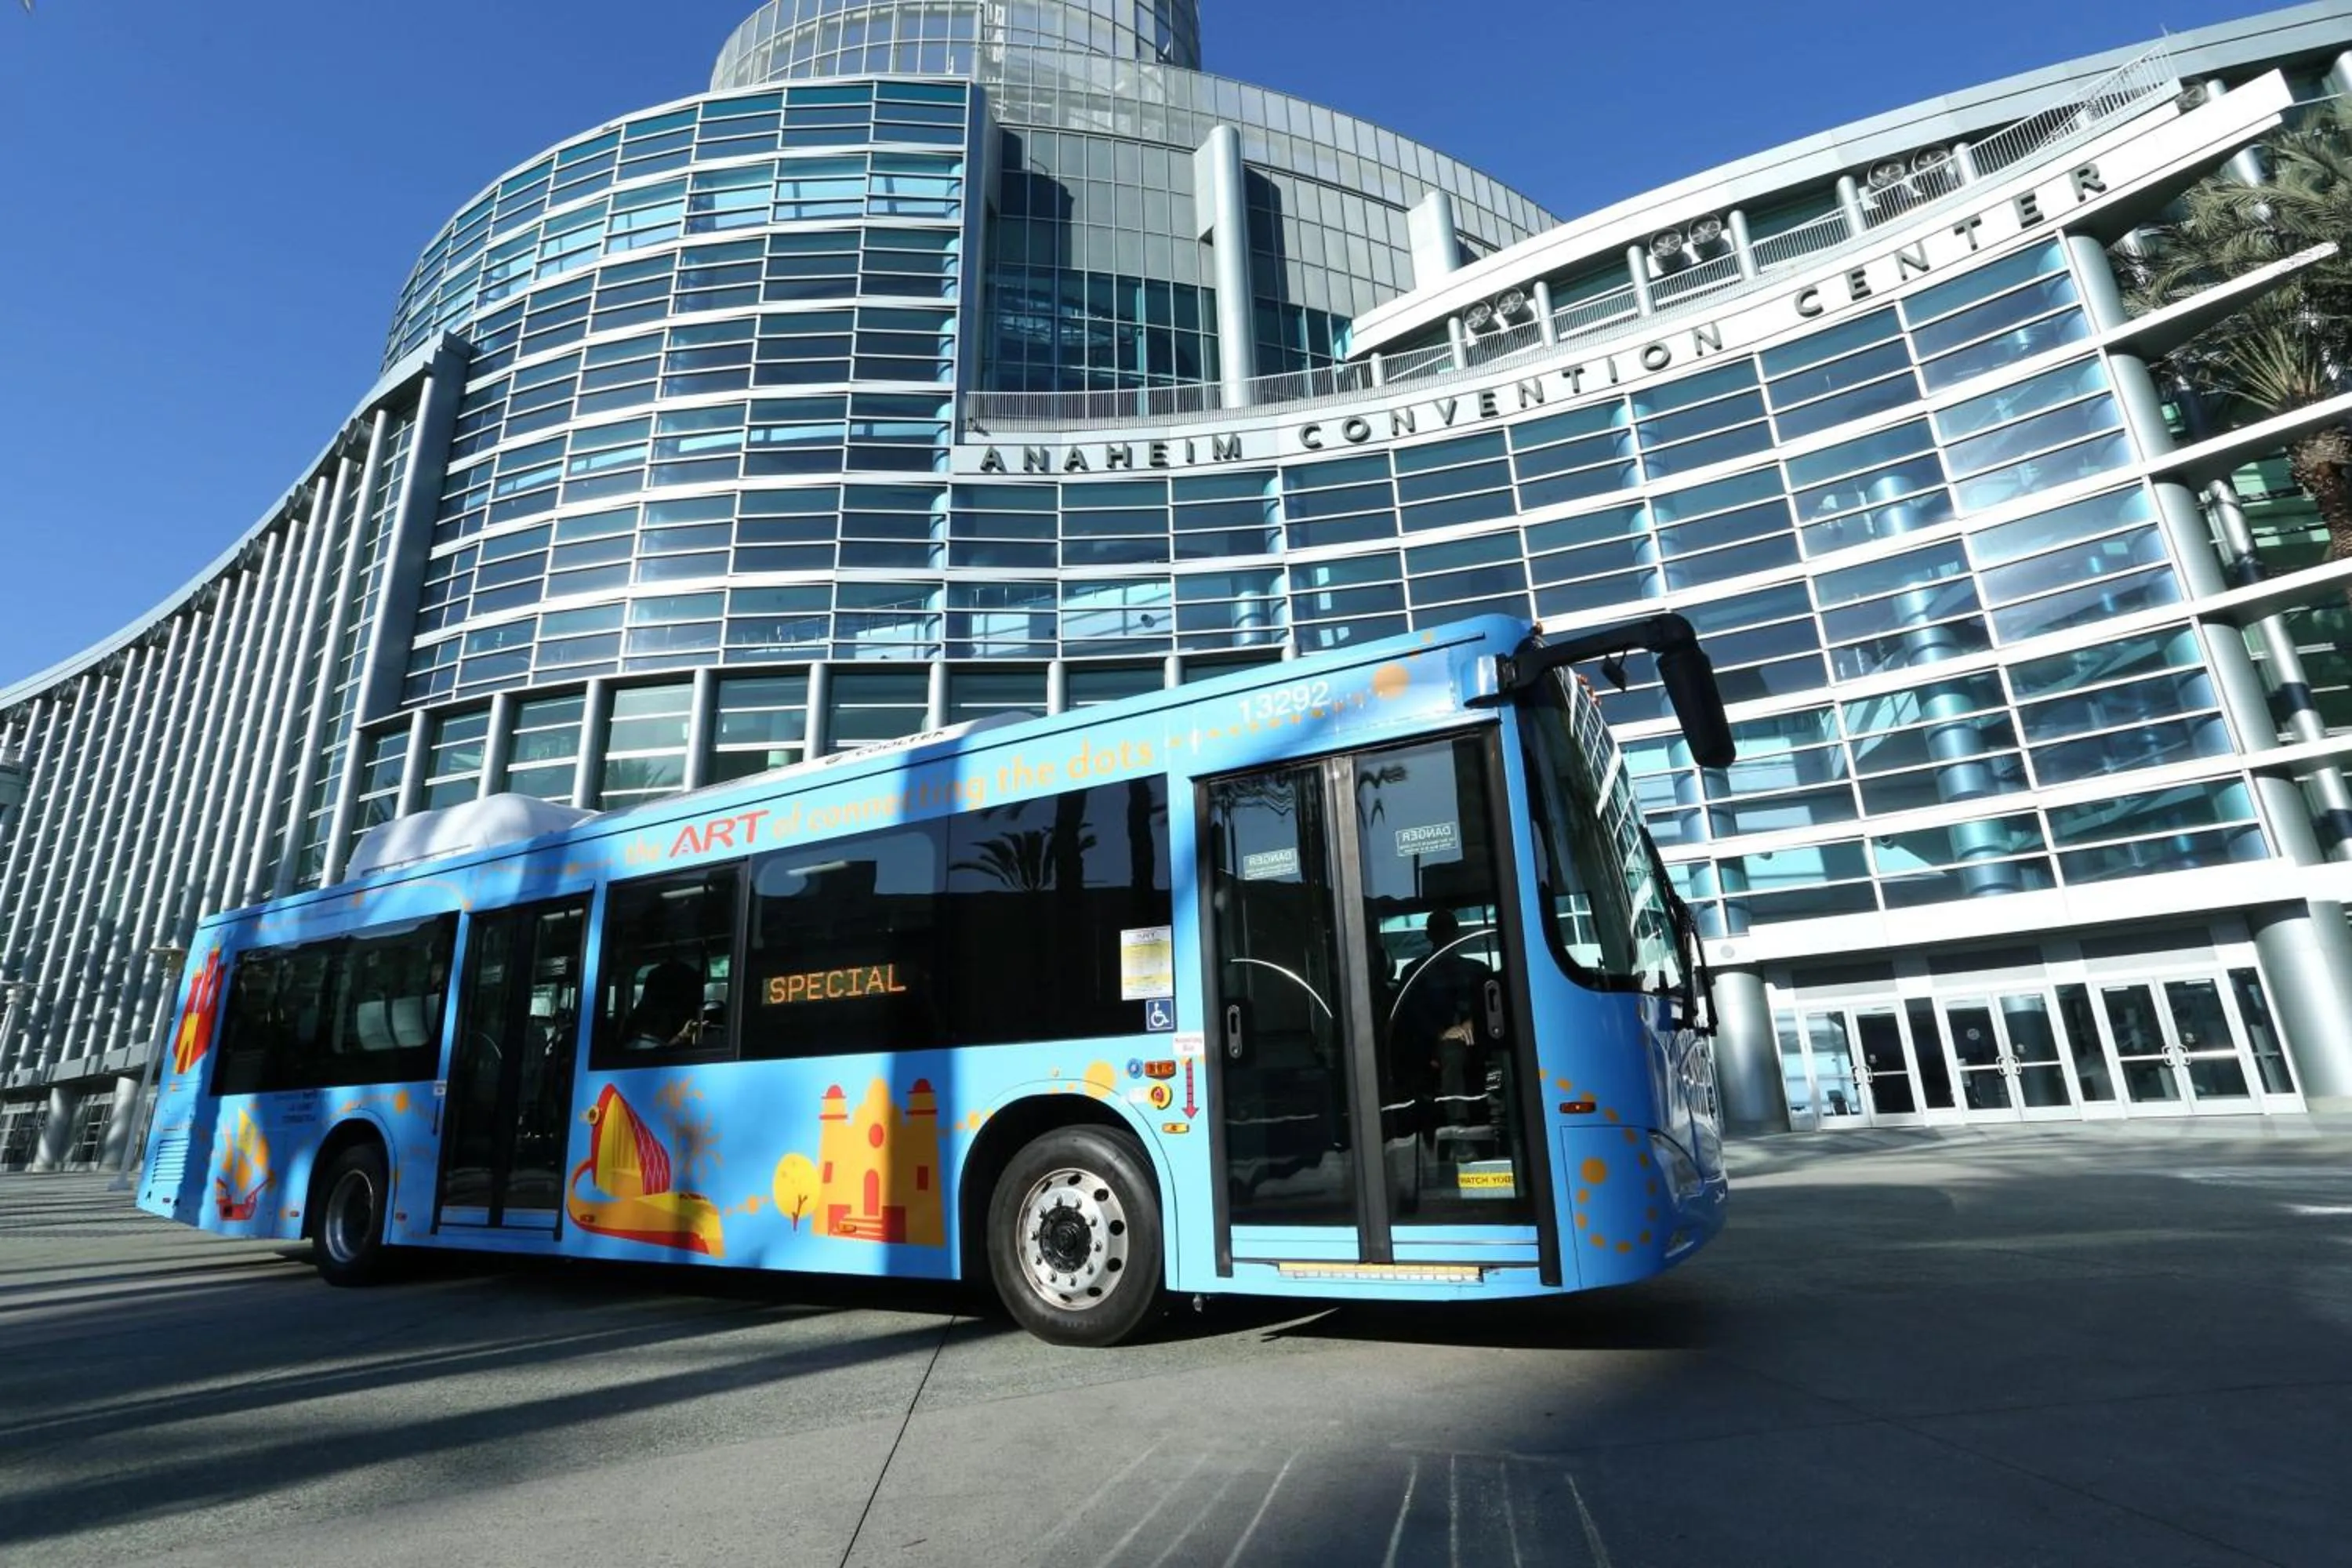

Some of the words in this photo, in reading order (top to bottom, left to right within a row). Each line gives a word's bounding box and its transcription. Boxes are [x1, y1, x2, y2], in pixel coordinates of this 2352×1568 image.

[979, 432, 1243, 473] ANAHEIM
[1298, 325, 1723, 450] CONVENTION
[1793, 161, 2108, 318] CENTER
[1240, 681, 1332, 723] 13292
[669, 809, 770, 858] ART
[773, 800, 801, 839] of
[808, 775, 987, 831] connecting
[996, 753, 1055, 794] the
[1067, 736, 1154, 779] dots
[769, 963, 906, 1004] SPECIAL
